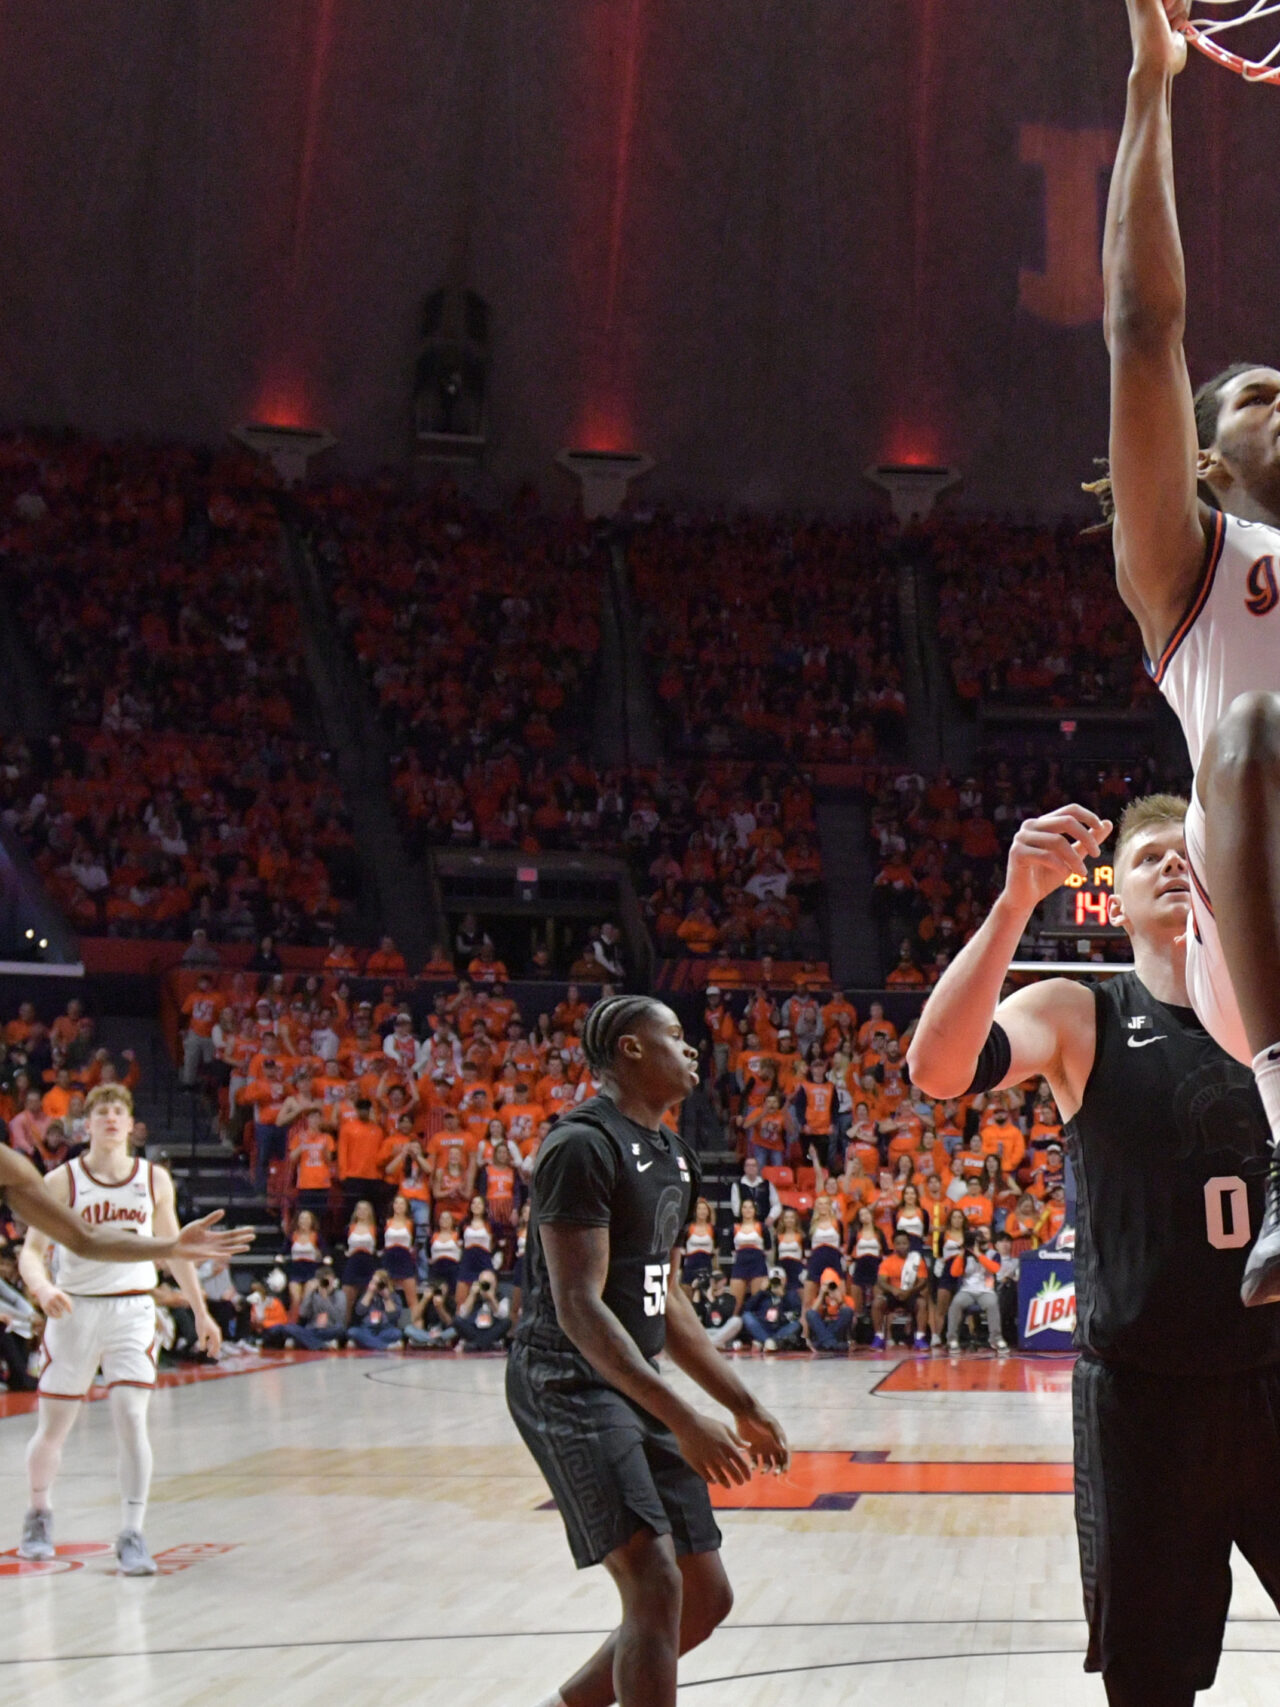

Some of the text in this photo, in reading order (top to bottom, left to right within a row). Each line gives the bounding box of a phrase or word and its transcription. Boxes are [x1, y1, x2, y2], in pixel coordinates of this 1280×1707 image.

[1075, 891, 1108, 926] 14
[1127, 1015, 1147, 1030] JF
[1203, 1175, 1252, 1250] 0
